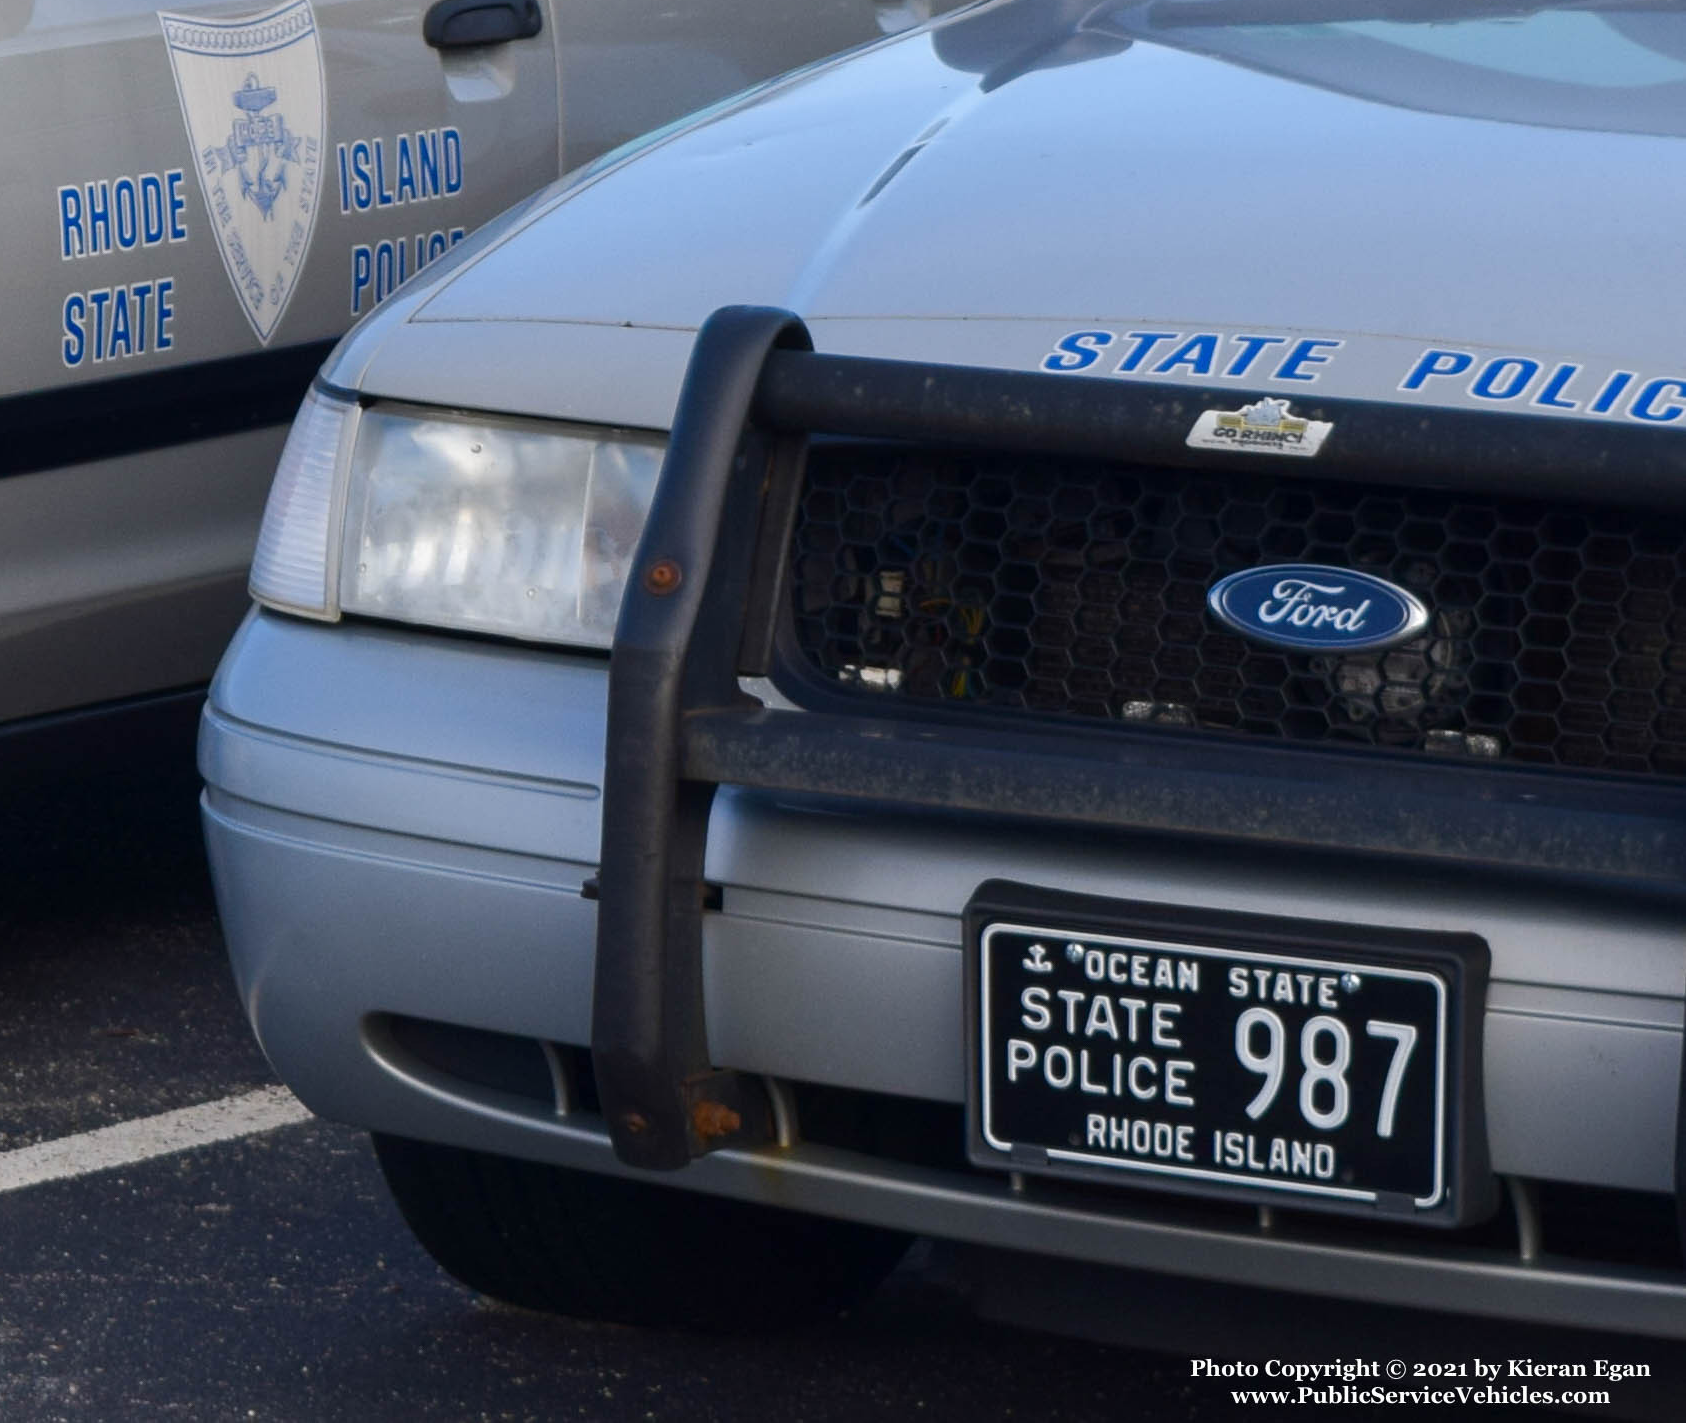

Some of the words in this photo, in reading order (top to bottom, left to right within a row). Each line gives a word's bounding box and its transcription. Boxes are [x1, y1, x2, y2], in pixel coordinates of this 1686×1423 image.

[58, 168, 187, 261] RHODE
[337, 126, 463, 215] ISLAND
[62, 277, 174, 368] STATE
[1040, 329, 1344, 382] STATE
[1258, 579, 1370, 632] Ford
[1083, 949, 1199, 992] OCEAN
[1228, 967, 1339, 1009] STATE
[1021, 987, 1182, 1048] STATE
[1007, 1039, 1195, 1107] POLICE
[1235, 1007, 1418, 1137] 987
[1087, 1113, 1195, 1162] RHODE
[1213, 1130, 1335, 1179] ISLAND
